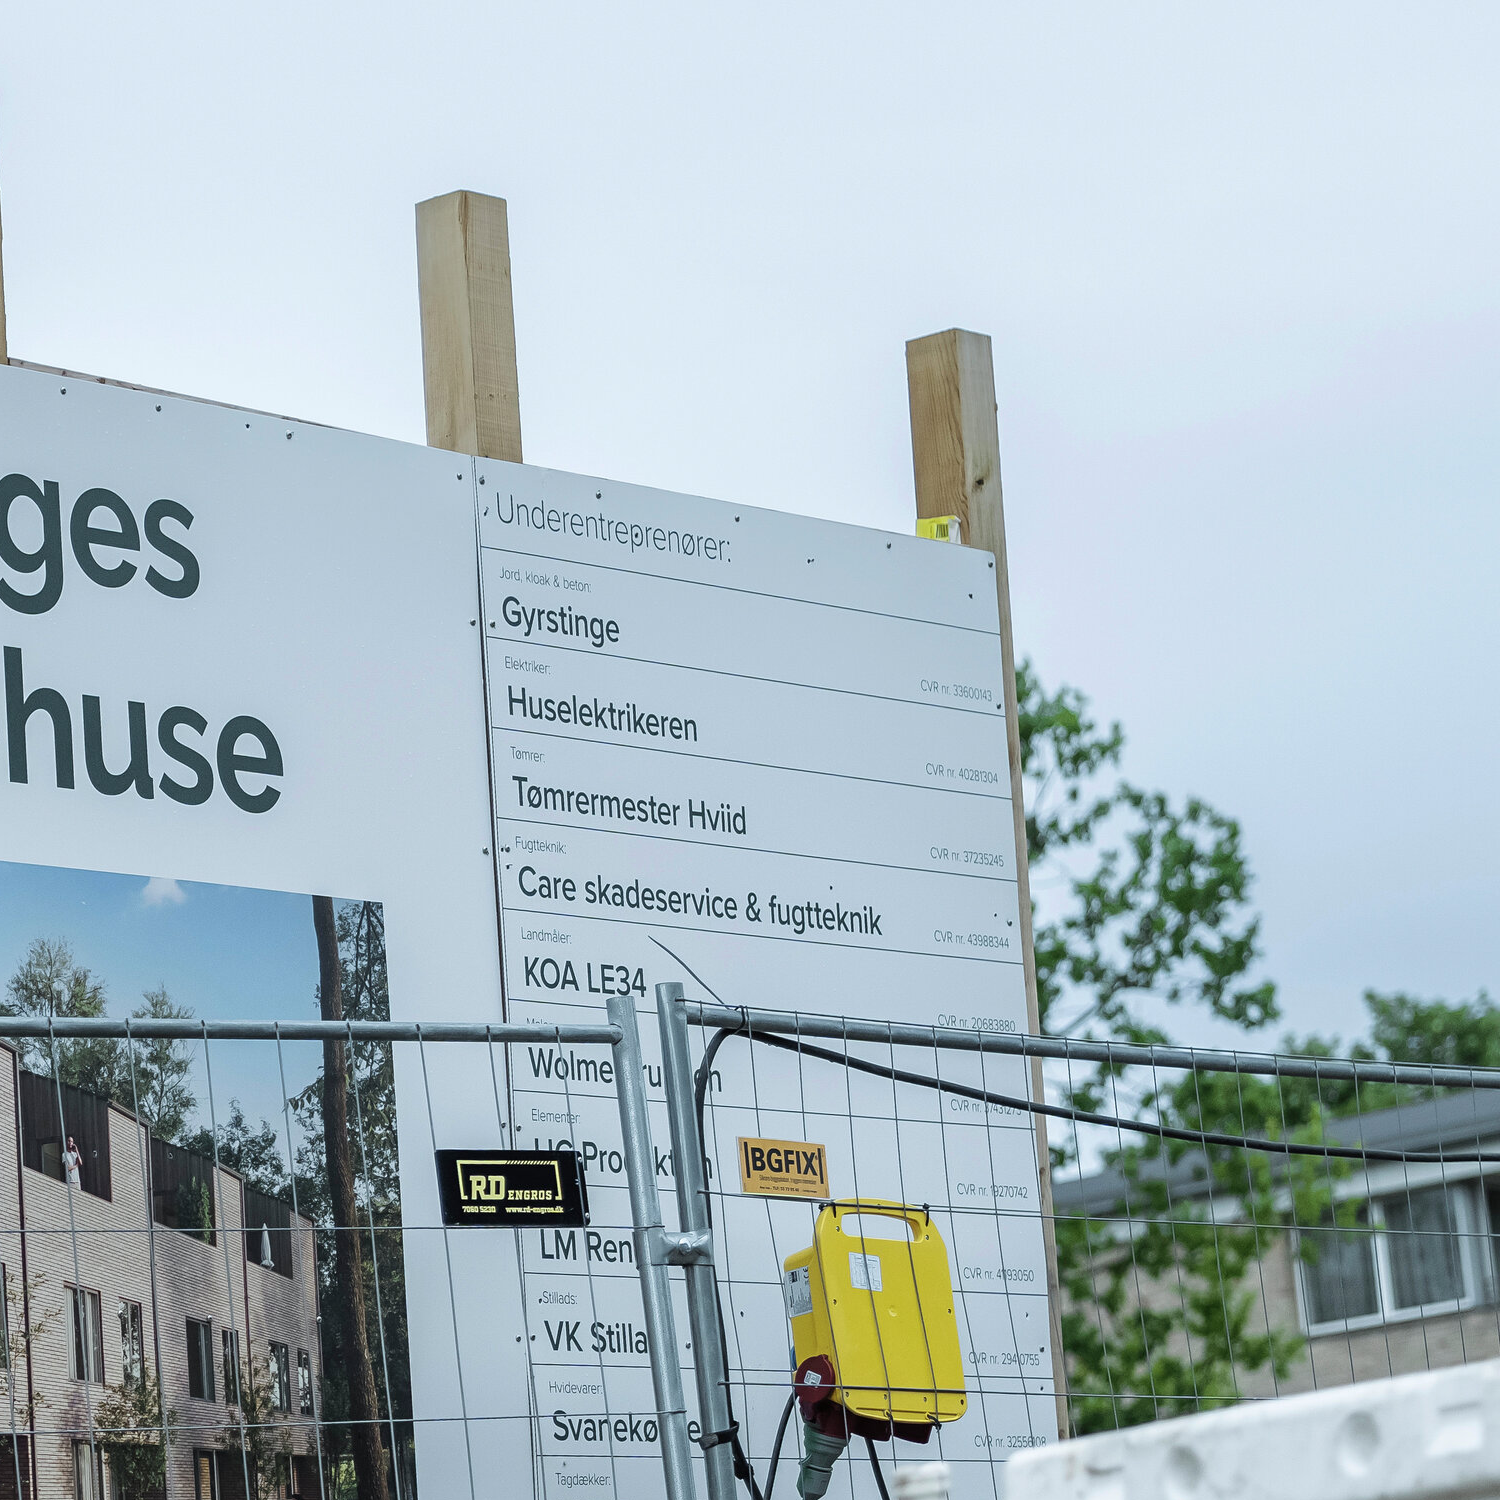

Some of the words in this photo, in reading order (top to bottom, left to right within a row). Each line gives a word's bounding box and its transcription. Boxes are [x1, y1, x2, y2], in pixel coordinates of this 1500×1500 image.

[496, 492, 731, 563] Underentreprenører:
[499, 566, 523, 583] Jord,
[525, 571, 550, 586] kloak
[553, 574, 560, 588] &
[563, 576, 592, 593] beton:
[502, 596, 620, 648] Gyrstinge
[504, 655, 551, 675] Elektriker:
[920, 679, 939, 693] CVR
[941, 685, 951, 695] nr.
[953, 684, 992, 702] 33600143
[507, 685, 698, 742] Huselektrikeren
[510, 745, 546, 764] Tømrer:
[925, 763, 944, 777] CVR
[947, 768, 957, 779] nr.
[512, 775, 680, 826] Tømrermester
[688, 798, 747, 835] Hviid
[515, 836, 567, 855] Fugtteknik:
[930, 846, 949, 860] CVR
[952, 851, 961, 862] nr.
[963, 850, 1004, 867] 37235245
[518, 865, 576, 901] Care
[585, 874, 738, 920] skadeservice
[745, 891, 761, 922] &
[768, 895, 883, 936] fugtteknik
[521, 926, 572, 945] Landmåler:
[934, 930, 953, 943] CVR
[955, 934, 966, 945] nr.
[524, 955, 579, 991] KOA
[586, 961, 646, 998] LE34
[938, 1014, 957, 1027] CVR
[959, 1018, 969, 1028] nr.
[950, 1098, 969, 1111] CVR
[972, 1103, 982, 1113] nr.
[531, 1108, 580, 1125] Elementer:
[751, 1147, 818, 1176] BGFIX
[469, 1175, 506, 1200] RD
[507, 1190, 552, 1200] ENGROS
[956, 1182, 976, 1196] CVR
[978, 1186, 988, 1197] nr.
[540, 1228, 577, 1261] LM
[586, 1231, 633, 1263] Ren
[963, 1266, 982, 1279] CVR
[985, 1270, 994, 1280] nr.
[542, 1290, 578, 1305] Stillads:
[543, 1320, 584, 1352] VK
[590, 1321, 648, 1354] Stilla
[969, 1351, 987, 1364] CVR
[989, 1354, 999, 1365] nr.
[1001, 1352, 1040, 1366] 2940755
[549, 1381, 603, 1395] Hvidevarer:
[974, 1435, 992, 1448] CVR
[995, 1438, 1004, 1448] nr.
[555, 1472, 611, 1488] Tagdækker:
